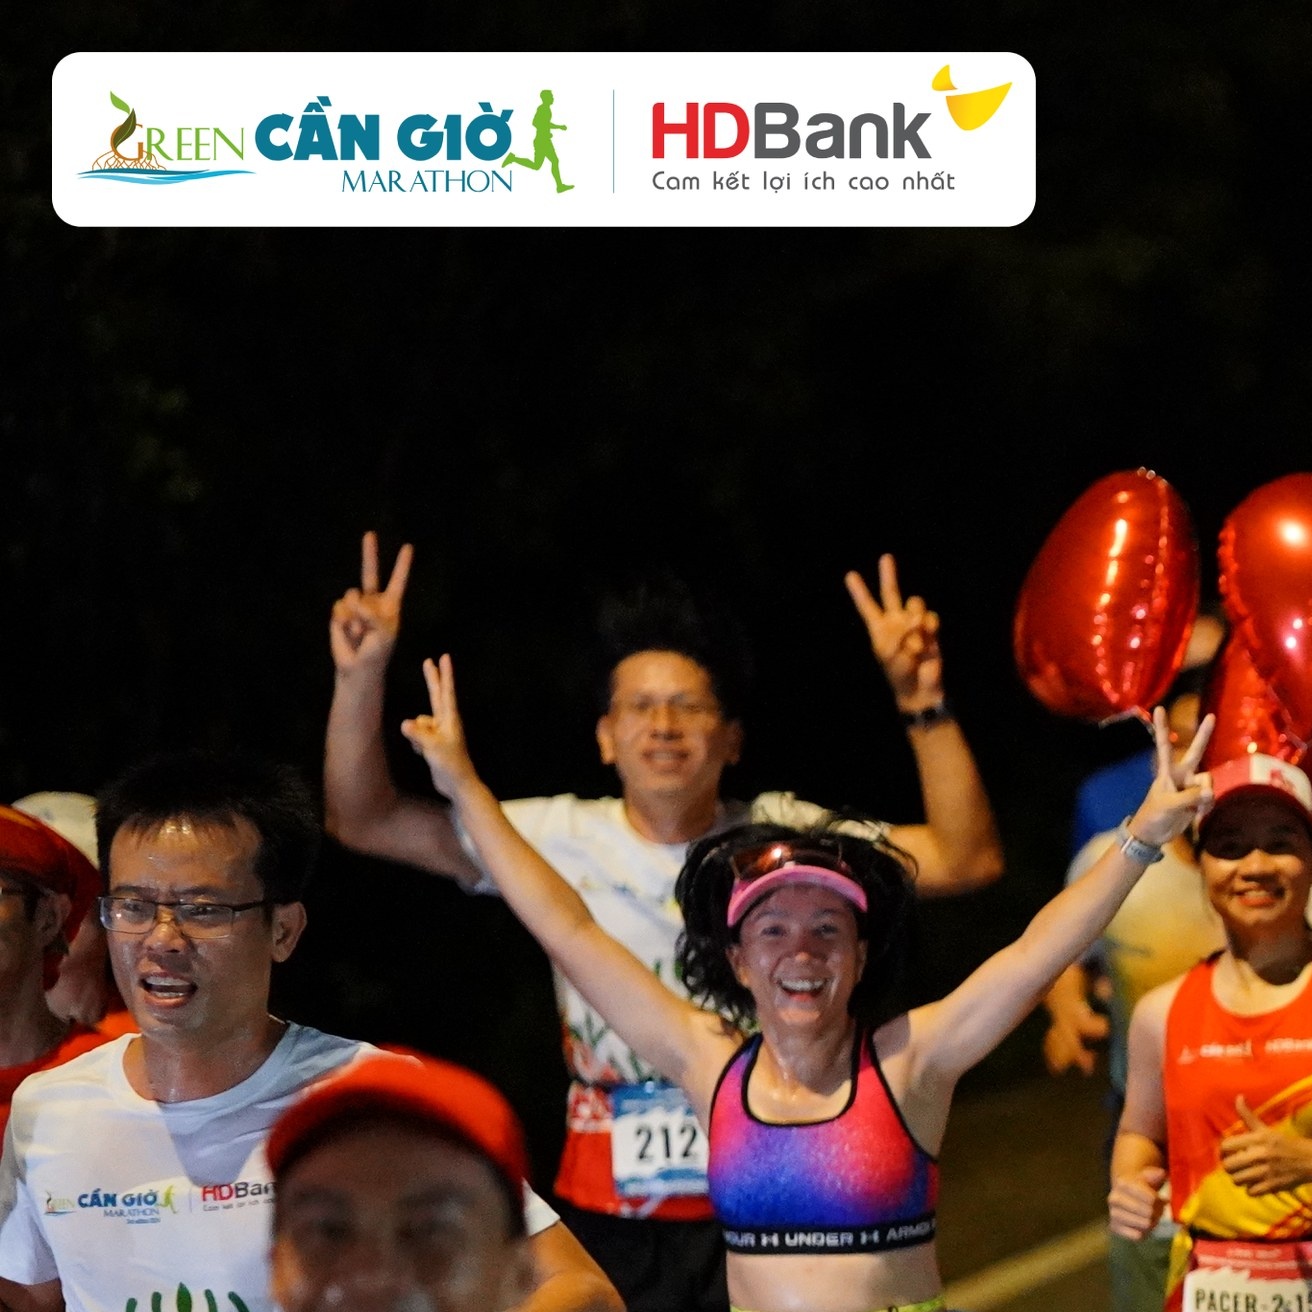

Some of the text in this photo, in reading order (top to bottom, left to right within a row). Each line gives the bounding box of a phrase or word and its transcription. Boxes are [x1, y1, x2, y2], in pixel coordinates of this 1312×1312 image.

[636, 1124, 698, 1160] 212
[202, 1181, 276, 1202] HDBan
[103, 1208, 160, 1218] MARATHON
[785, 1231, 854, 1247] UNDER
